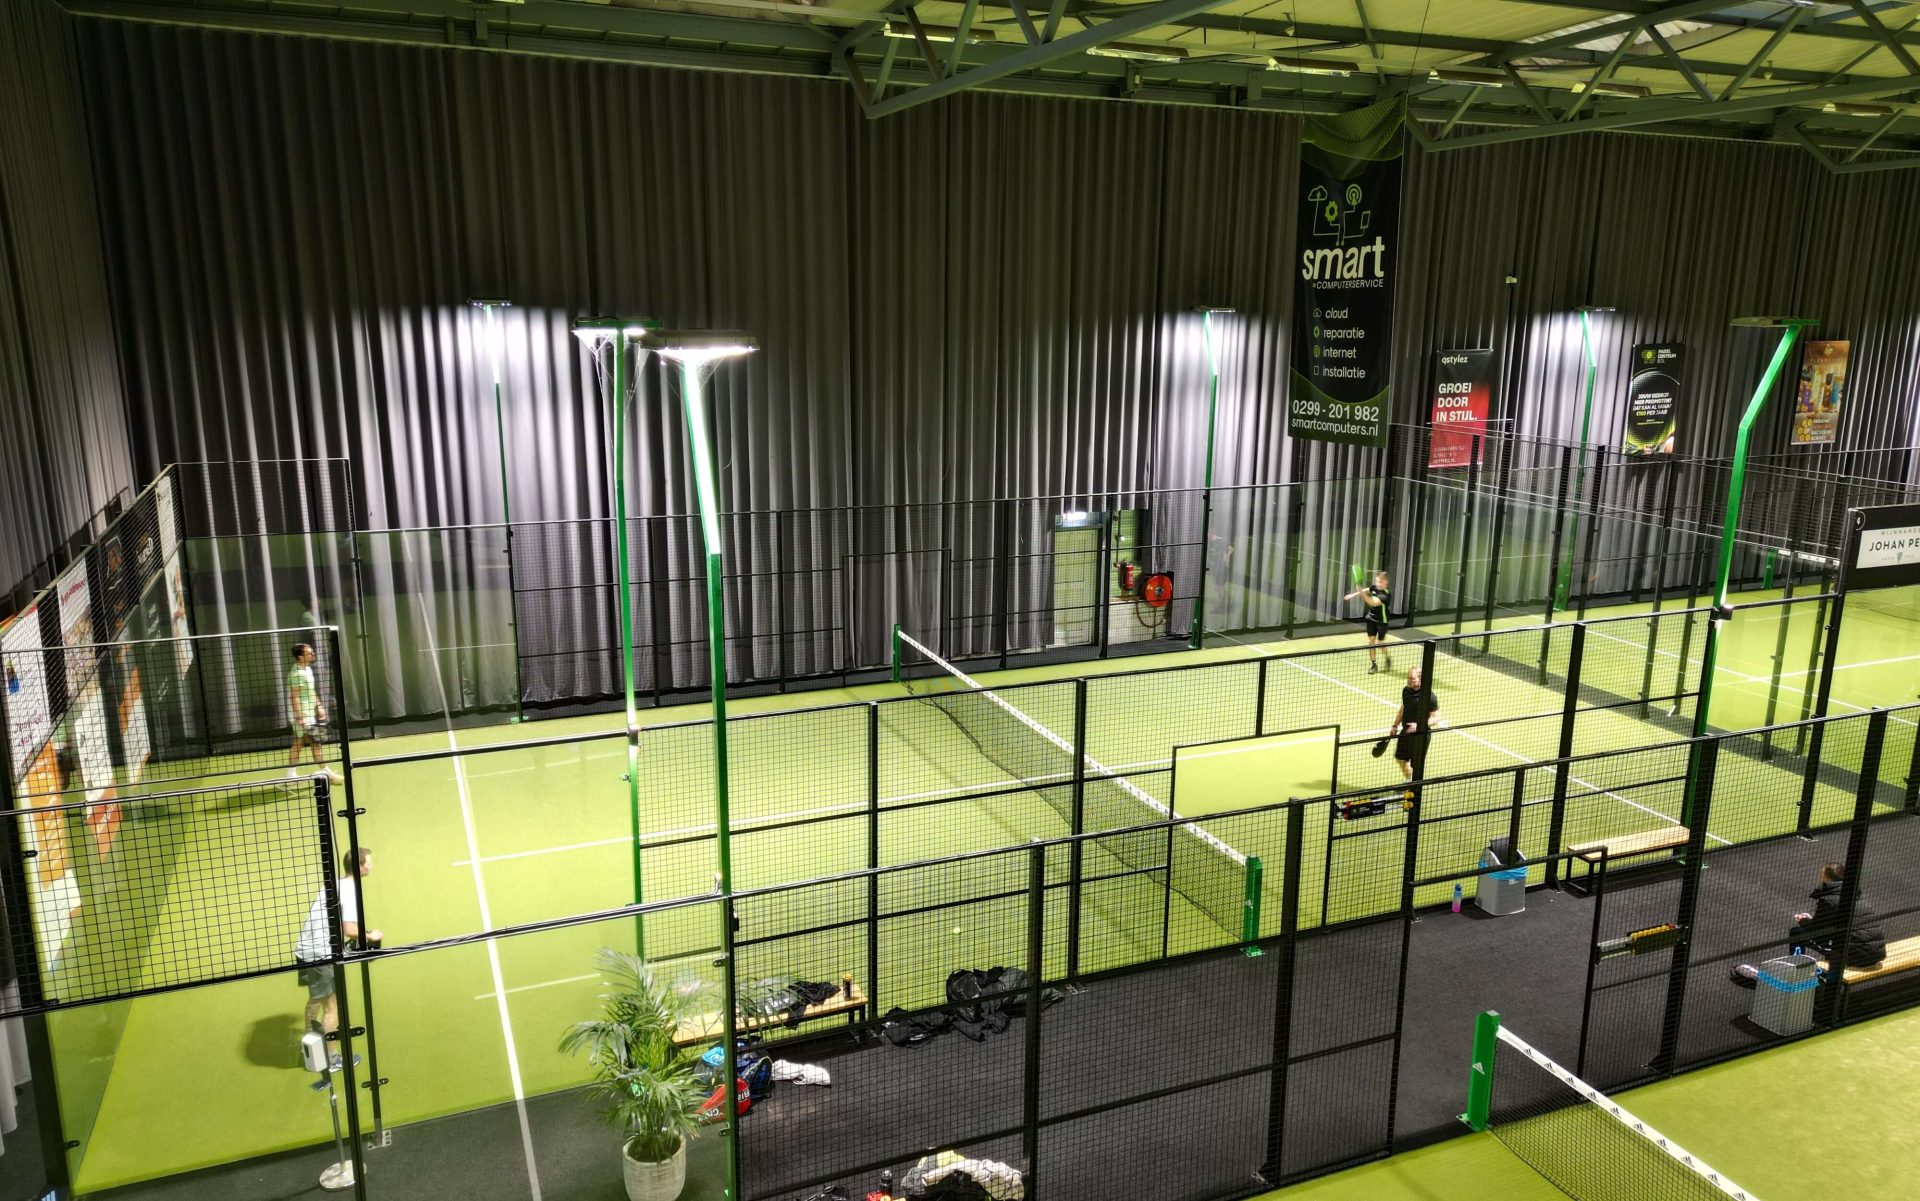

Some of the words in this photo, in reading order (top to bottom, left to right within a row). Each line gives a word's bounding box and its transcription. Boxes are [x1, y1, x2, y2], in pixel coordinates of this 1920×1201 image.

[1302, 236, 1385, 280] smart
[1316, 279, 1384, 290] COMPUTERSERVICE
[1325, 307, 1348, 319] cloud
[1323, 327, 1365, 340] reparatie
[1322, 345, 1357, 359] internet
[1322, 364, 1366, 378] installatie
[1438, 382, 1472, 394] GROEI
[1437, 397, 1469, 408] DOOR
[1292, 400, 1320, 416] 0299
[1328, 403, 1350, 419] 201
[1354, 405, 1379, 422] 982
[1436, 411, 1447, 422] IN
[1448, 410, 1478, 421] STIJL.
[1291, 418, 1379, 436] smartcomputers.nl
[1869, 539, 1905, 552] JOHAN
[1908, 537, 1920, 548] PE
